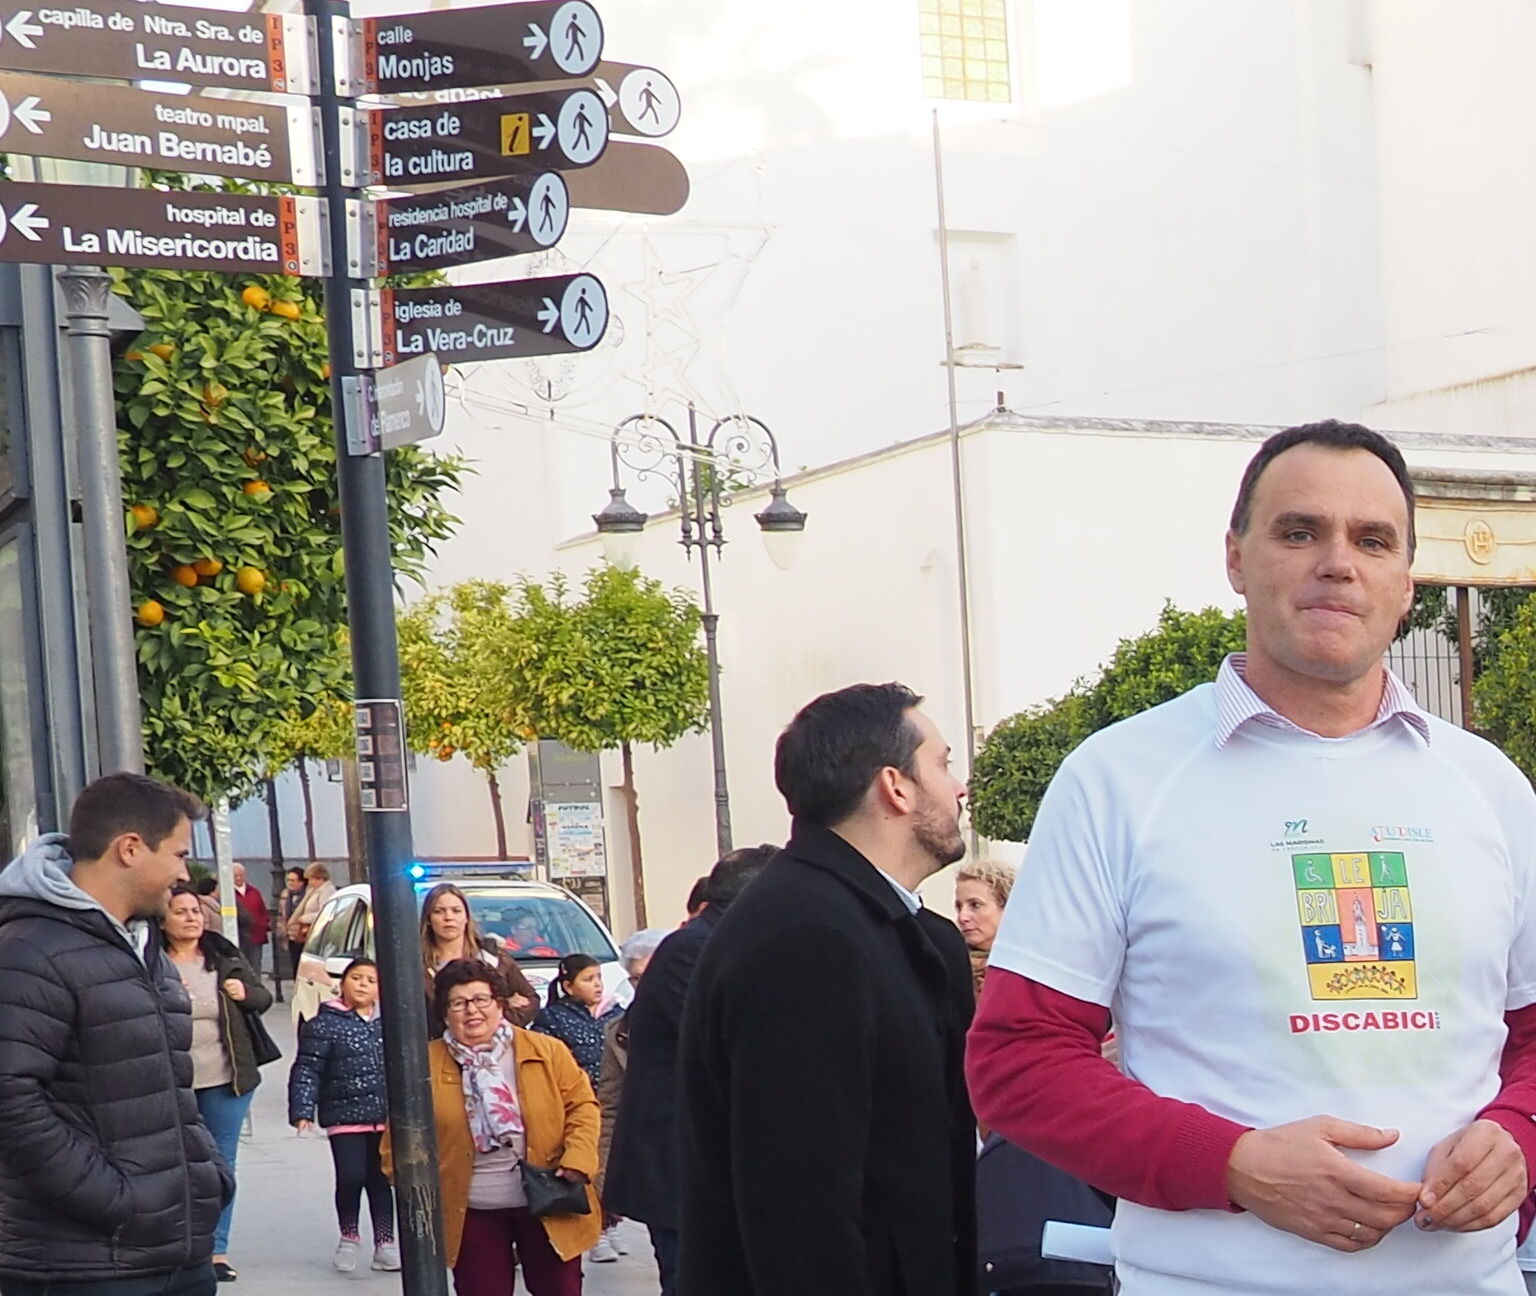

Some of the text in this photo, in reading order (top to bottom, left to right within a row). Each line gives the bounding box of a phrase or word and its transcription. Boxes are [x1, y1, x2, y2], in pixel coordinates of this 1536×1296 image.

[38, 8, 264, 44] capilla de Ntra. Sra. de
[377, 26, 413, 46] calle
[135, 43, 267, 79] La Aurora
[378, 52, 454, 82] Monjas
[154, 104, 270, 135] teatro mpal.
[384, 111, 460, 140] casa de
[83, 124, 272, 168] Juan Bernabé
[384, 149, 474, 177] la cultura
[166, 203, 276, 228] hospital de
[388, 193, 508, 228] residencia hospital de
[62, 226, 279, 262] La Misericordia
[389, 226, 475, 262] La Caridad
[395, 298, 462, 323] iglesia de
[397, 323, 514, 353] La Vera-Cruz
[1289, 1011, 1434, 1033] DISCABICI
